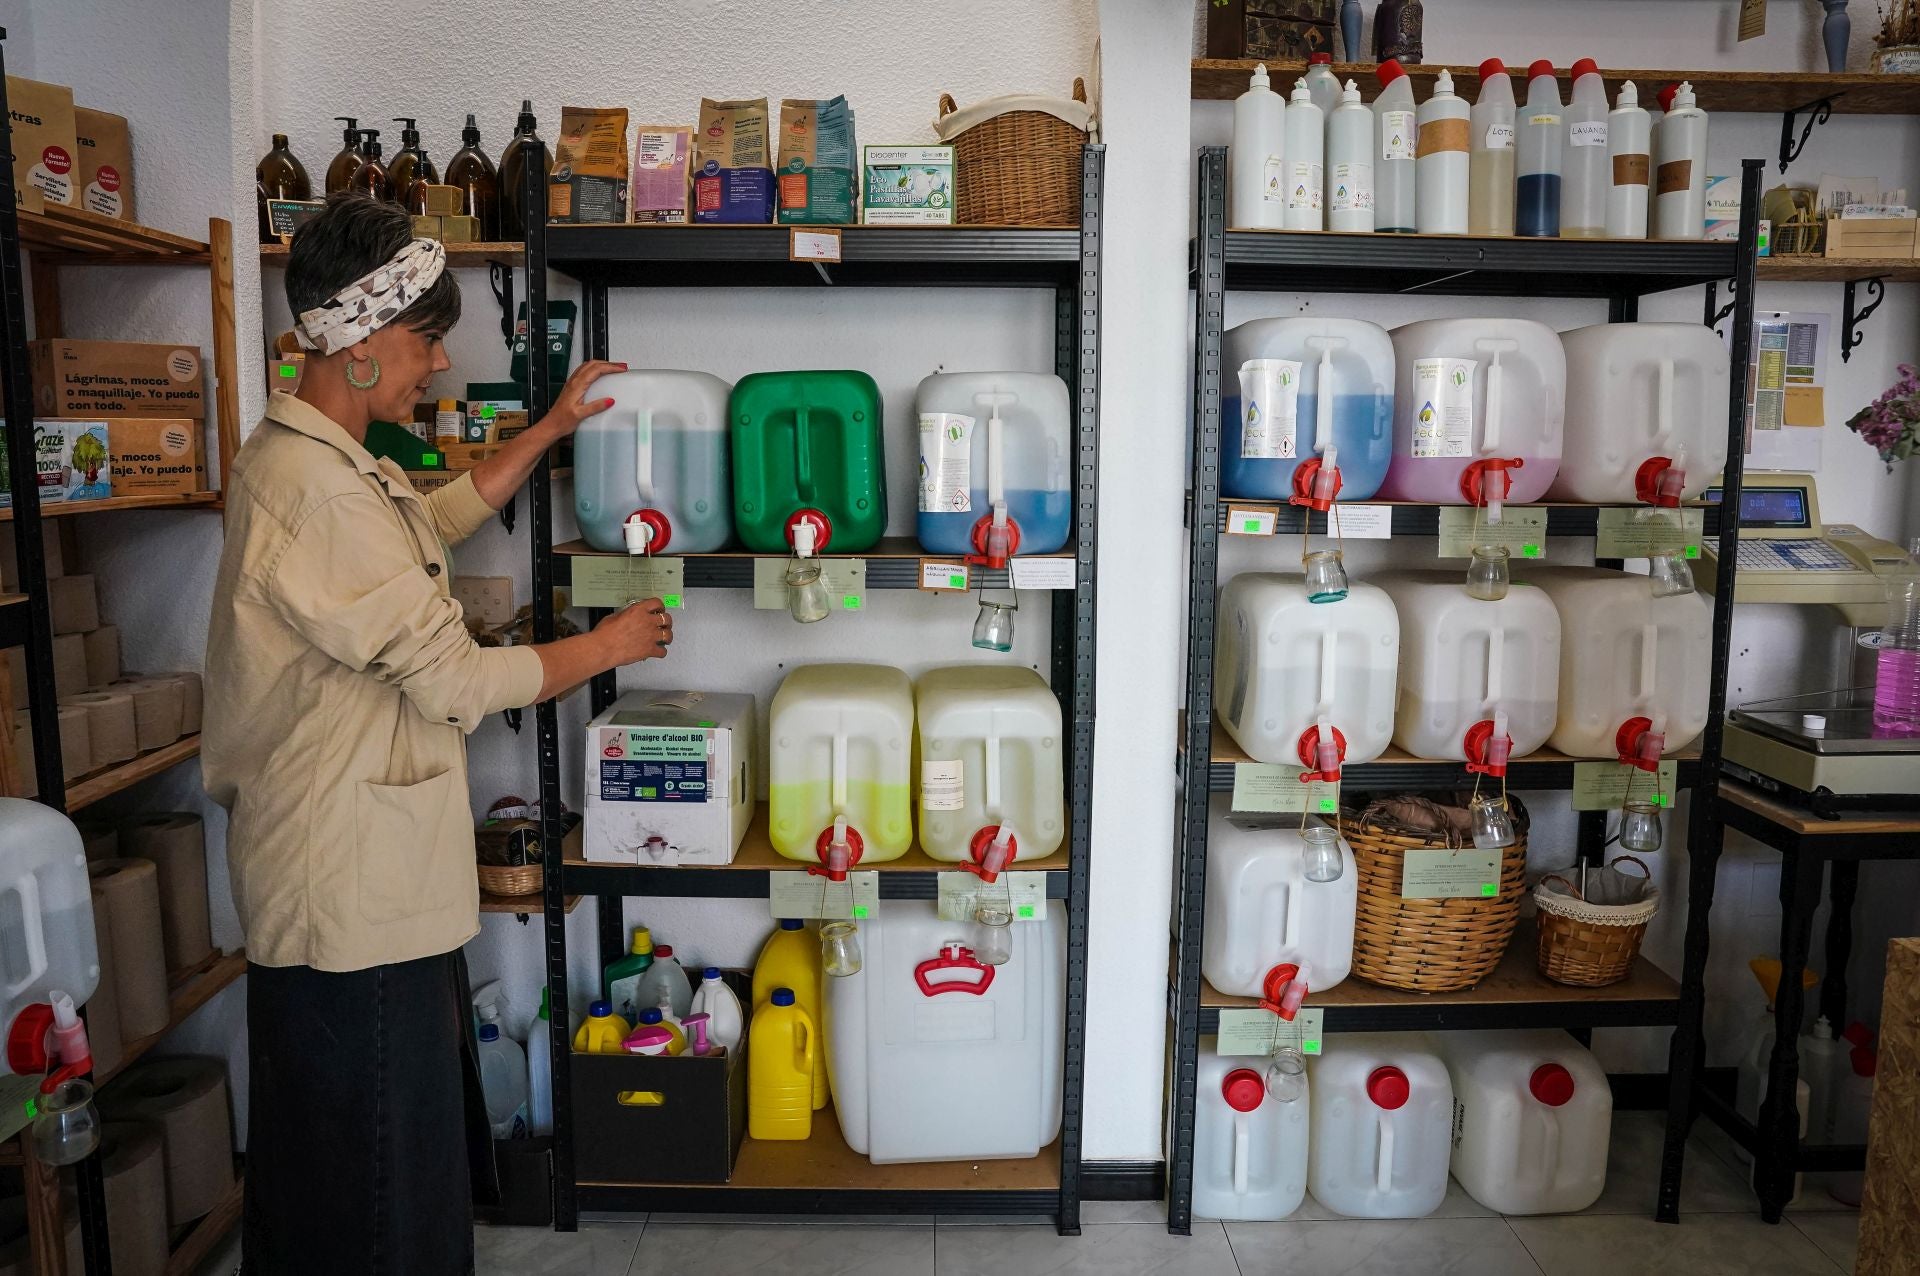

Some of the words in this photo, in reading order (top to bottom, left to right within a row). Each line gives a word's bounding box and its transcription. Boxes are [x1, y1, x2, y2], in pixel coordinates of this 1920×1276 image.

[1492, 128, 1513, 136] LOTO
[48, 152, 65, 160] Nuevo
[870, 151, 908, 159] biocenter
[870, 175, 888, 184] Eco
[870, 184, 907, 193] Pastillas
[870, 194, 923, 205] Lavavajillas
[65, 373, 128, 386] Lágrimas,
[130, 377, 170, 386] mocos
[66, 388, 75, 397] o
[78, 388, 145, 400] maquillaje.
[148, 389, 162, 398] Yo
[165, 389, 200, 400] puedo
[67, 402, 91, 410] con
[94, 401, 126, 410] todo.
[122, 454, 162, 462] mocos
[36, 460, 62, 472] 100%
[140, 465, 154, 475] Yo
[157, 464, 192, 476] puedo
[420, 478, 448, 488] LIMPIEZA
[631, 733, 660, 742] Vinaigre
[662, 733, 689, 742] d'alcool
[690, 734, 703, 742] BIO
